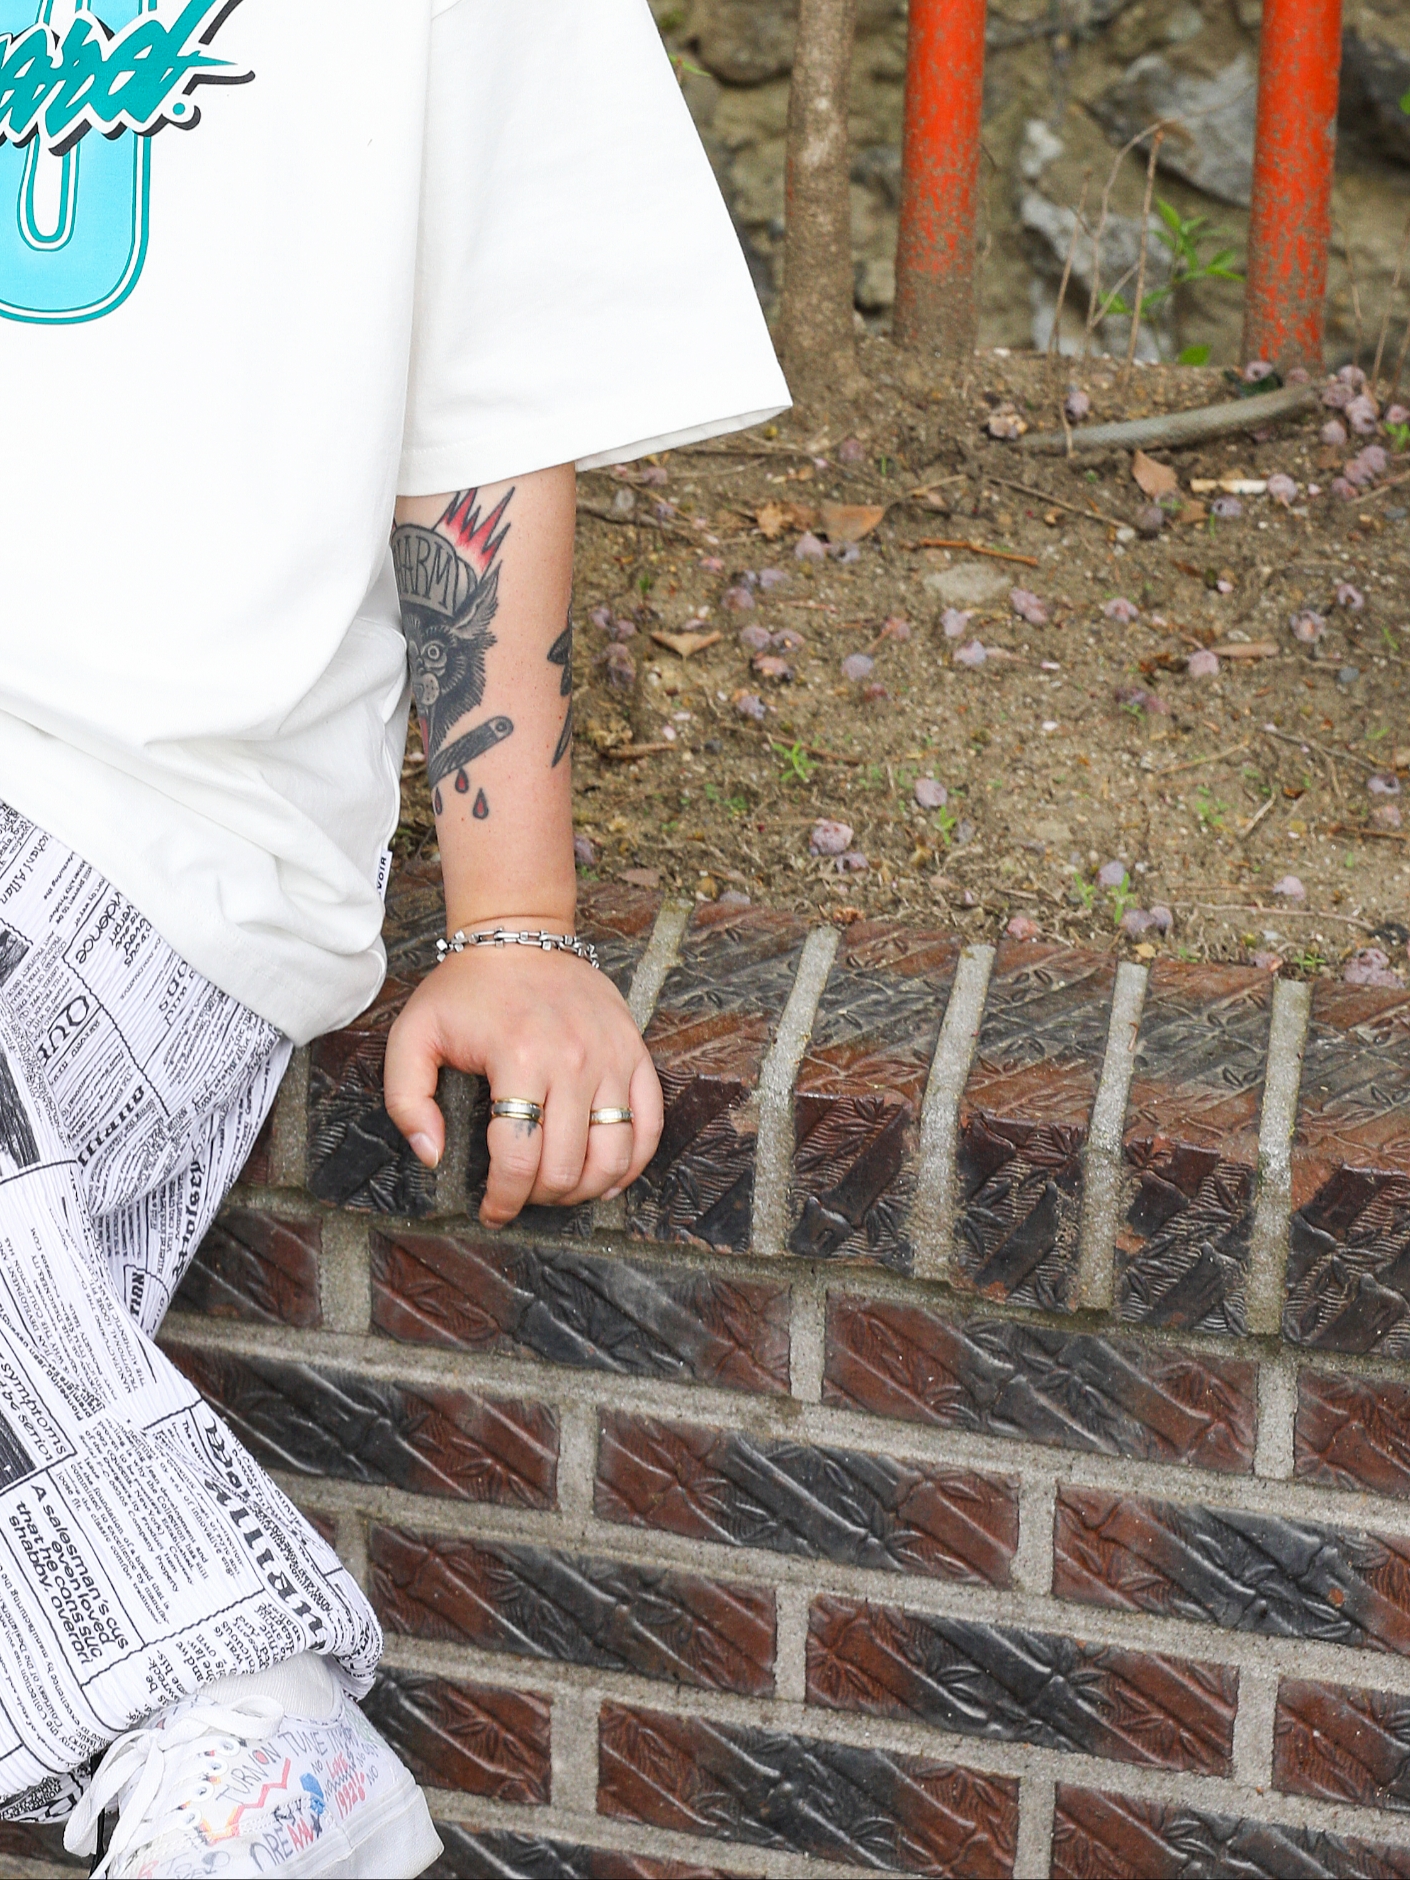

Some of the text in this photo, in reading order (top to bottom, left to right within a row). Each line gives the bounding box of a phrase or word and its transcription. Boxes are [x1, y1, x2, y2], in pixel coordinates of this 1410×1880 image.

[16, 1501, 103, 1658] that he cons suc
[51, 1541, 116, 1645] even loved
[106, 1617, 129, 1650] cus
